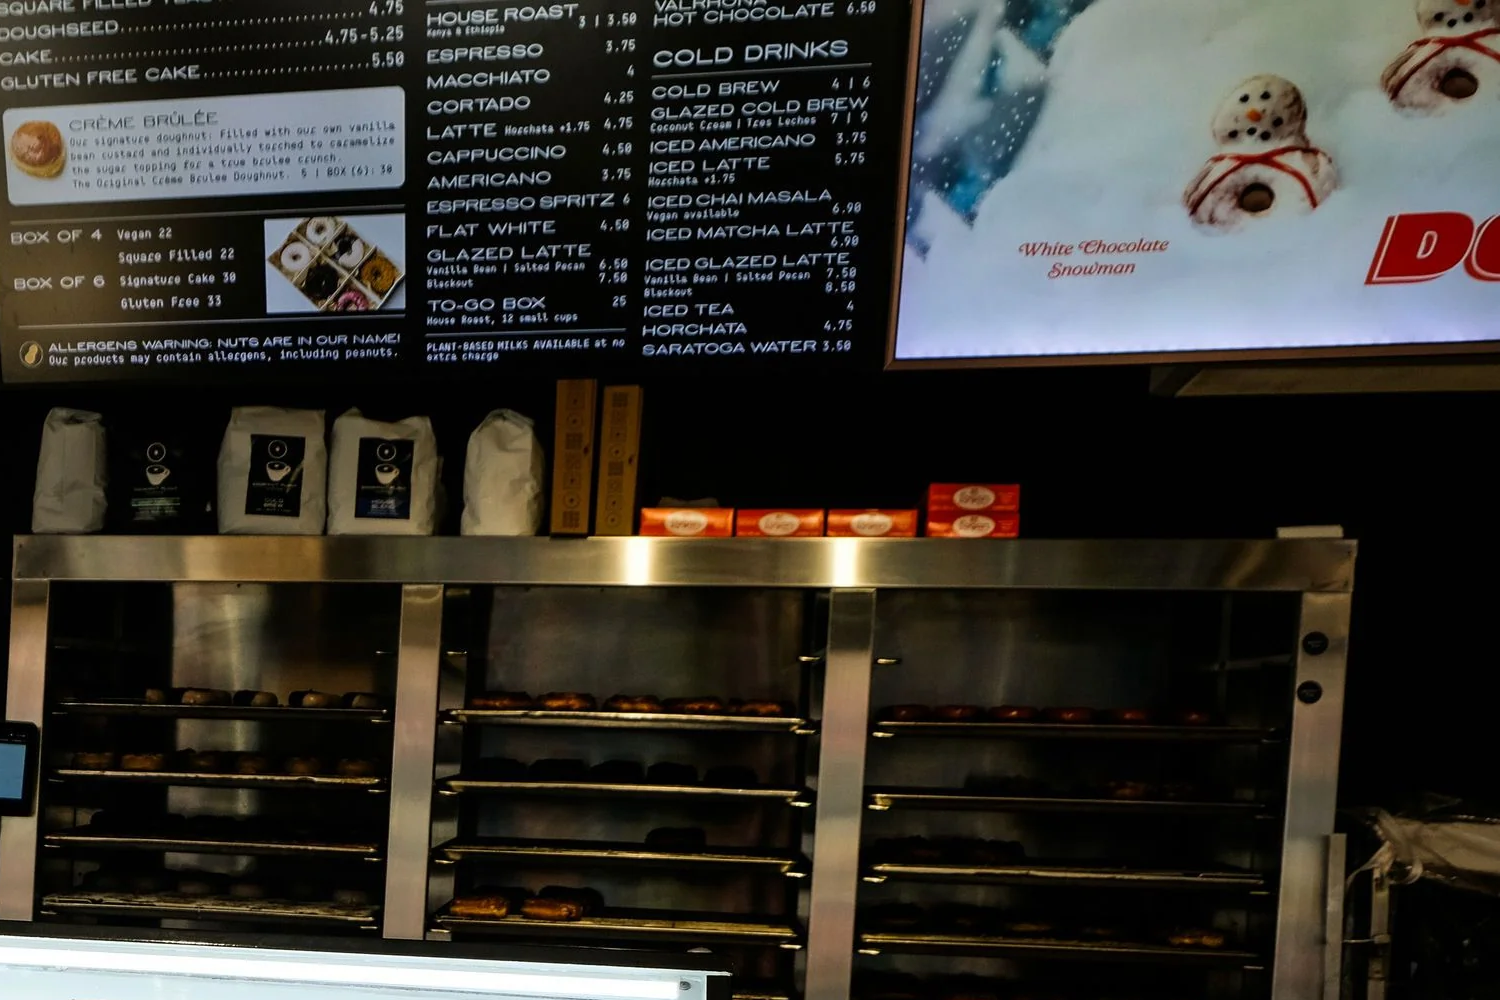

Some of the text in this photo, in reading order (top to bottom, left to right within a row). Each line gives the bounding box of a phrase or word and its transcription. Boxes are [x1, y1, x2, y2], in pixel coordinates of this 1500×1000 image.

[369, 0, 404, 16] 4.75
[427, 4, 636, 27] HOUSE ROAST 3.50
[653, 1, 876, 28] HOT CHOCOLATE 6.50
[427, 39, 636, 64] ESPRESSO 3.75
[653, 40, 848, 68] COLD DRINKS
[1, 72, 80, 91] GLUTEN
[87, 69, 137, 84] FREE
[372, 52, 404, 68] 5.50
[427, 65, 634, 89] MACCHIATO 4
[652, 80, 780, 99] COLD BREW
[427, 91, 634, 116] CORTADO 4.25
[651, 96, 869, 120] GLAZED COLD BREW
[69, 114, 135, 132] CRÈME
[427, 117, 633, 141] LATTE 4.75
[650, 131, 867, 154] ICED AMERICANO 3.75
[427, 142, 632, 165] CAPPUCCINO 4.50
[649, 152, 865, 175] ICED LATTE 5.75
[427, 168, 631, 190] AMERICANO 3.75
[427, 193, 630, 215] ESPRESSO SPRITZ 6
[648, 189, 832, 210] ICED CHAI MASALA
[832, 201, 861, 215] 6.90
[11, 229, 102, 244] BOX OF 4
[117, 227, 172, 241] Vegan 22
[427, 219, 629, 238] FLAT WHITE 4.50
[647, 221, 854, 242] ICED MATCHA LATTE
[830, 236, 859, 248] 6.90
[1018, 238, 1169, 259] White Chocolate
[118, 248, 235, 265] Square Filled 22
[427, 244, 591, 263] GLAZED LATTE
[645, 253, 850, 272] ICED GLAZED LATTE
[599, 259, 628, 271] 6.50
[827, 268, 857, 279] 7.50
[1046, 260, 1136, 279] Snowman
[14, 275, 105, 291] BOX OF 6
[120, 272, 236, 288] Signature Cake 30
[599, 272, 627, 284] 7.50
[825, 282, 856, 294] 8.50
[121, 295, 221, 309] Gluten Free 33
[427, 296, 626, 313] TO-GO BOX 25
[643, 301, 854, 318] ICED TEA 4
[642, 320, 852, 337] HORCHATA 4.75
[49, 340, 137, 352] ALLERGENS
[142, 338, 212, 350] WARNING:
[218, 337, 259, 348] NUTS
[263, 336, 292, 347] ARE
[298, 335, 312, 345] IN
[316, 335, 347, 345] OUR
[642, 340, 851, 357] SARATOGA WATER 3.50
[49, 348, 399, 366] Our products may contain allergens, including peanuts.
